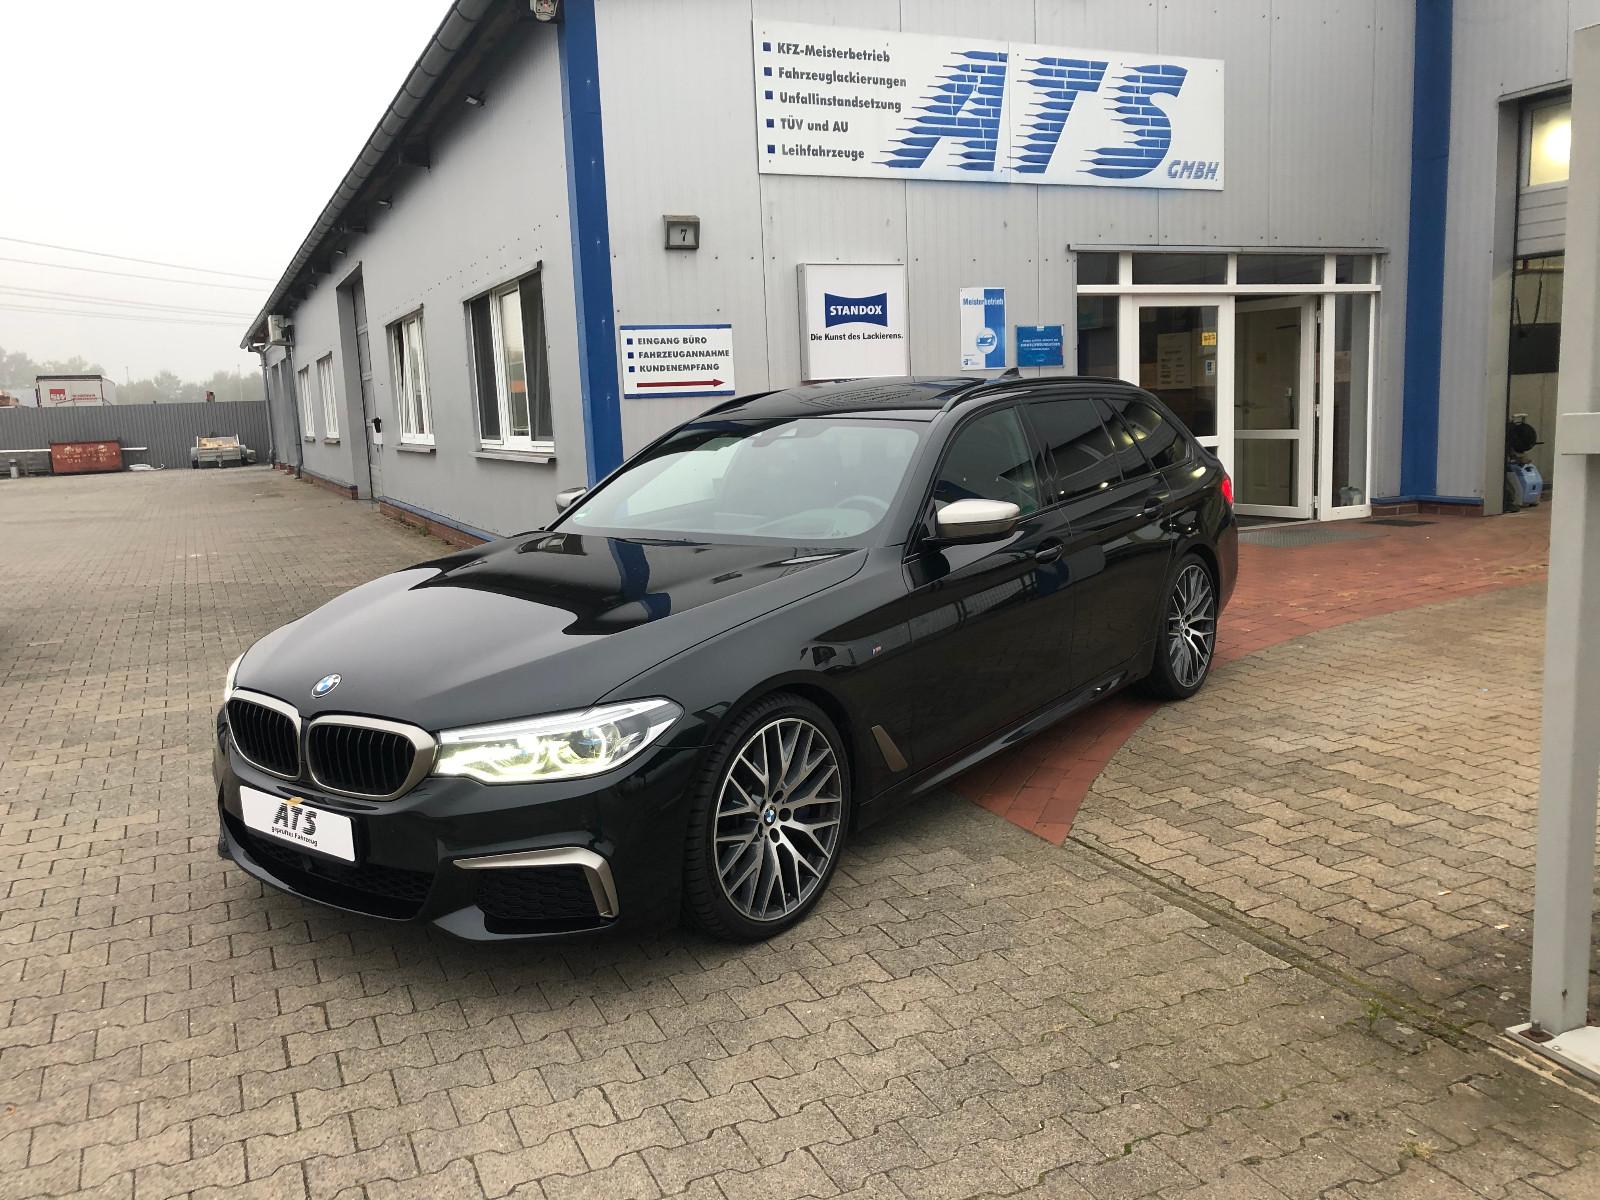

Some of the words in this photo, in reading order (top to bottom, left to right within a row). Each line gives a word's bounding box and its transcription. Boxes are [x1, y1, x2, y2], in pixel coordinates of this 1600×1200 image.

[777, 42, 890, 62] KFZ-Meisterbetrieb
[778, 67, 907, 88] Fahrzeuglackierungen
[780, 92, 902, 113] Unfallinstandsetzung
[780, 115, 803, 130] TÜV
[807, 120, 829, 132] und
[832, 121, 849, 132] AU
[871, 50, 1189, 180] ATS
[781, 144, 865, 161] Leihfahrzeuge
[1167, 161, 1219, 180] GMBH
[680, 229, 688, 242] 7
[829, 305, 883, 316] STANDOX
[962, 298, 1004, 306] Meisterbetrieb
[637, 337, 680, 345] EINGANG
[682, 335, 708, 344] BÜRO
[810, 333, 823, 341] Die
[824, 333, 846, 341] Kunst
[862, 332, 904, 340] Lackierens.
[638, 350, 730, 359] FAHRZEUGANNAHME
[639, 363, 720, 373] KUNDENEMPFANG
[272, 802, 318, 836] ATS
